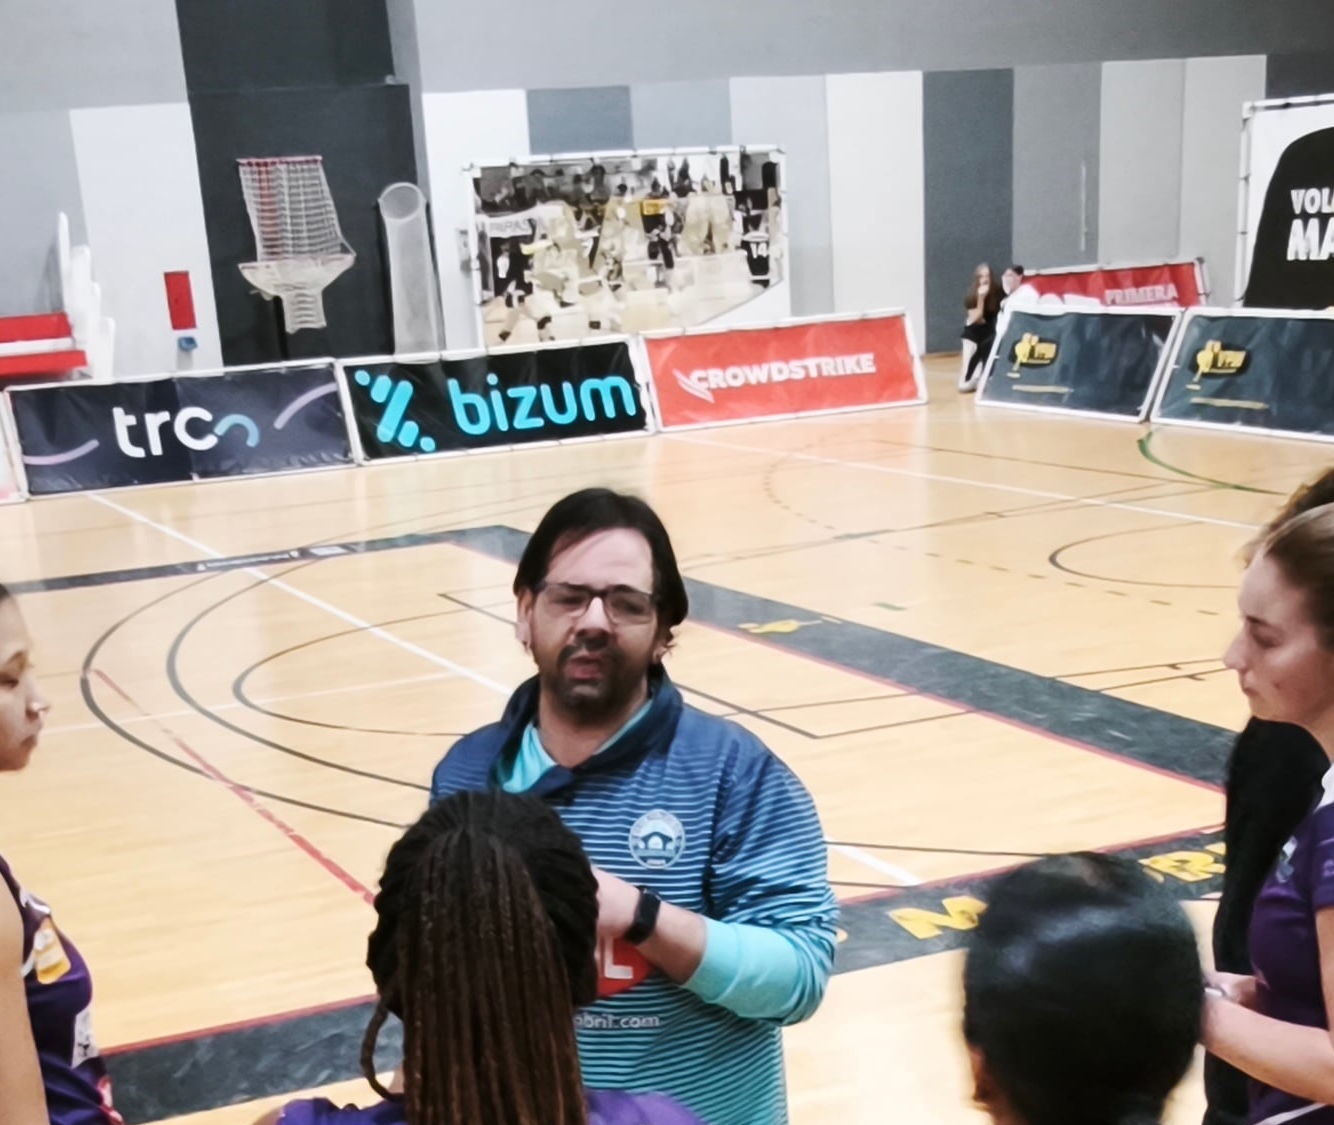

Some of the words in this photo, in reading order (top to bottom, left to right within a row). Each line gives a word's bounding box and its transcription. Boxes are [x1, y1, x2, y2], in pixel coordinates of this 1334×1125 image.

[1104, 282, 1180, 306] PRIMERA
[689, 353, 877, 391] CROWDSTRIKE
[447, 374, 637, 436] bizum
